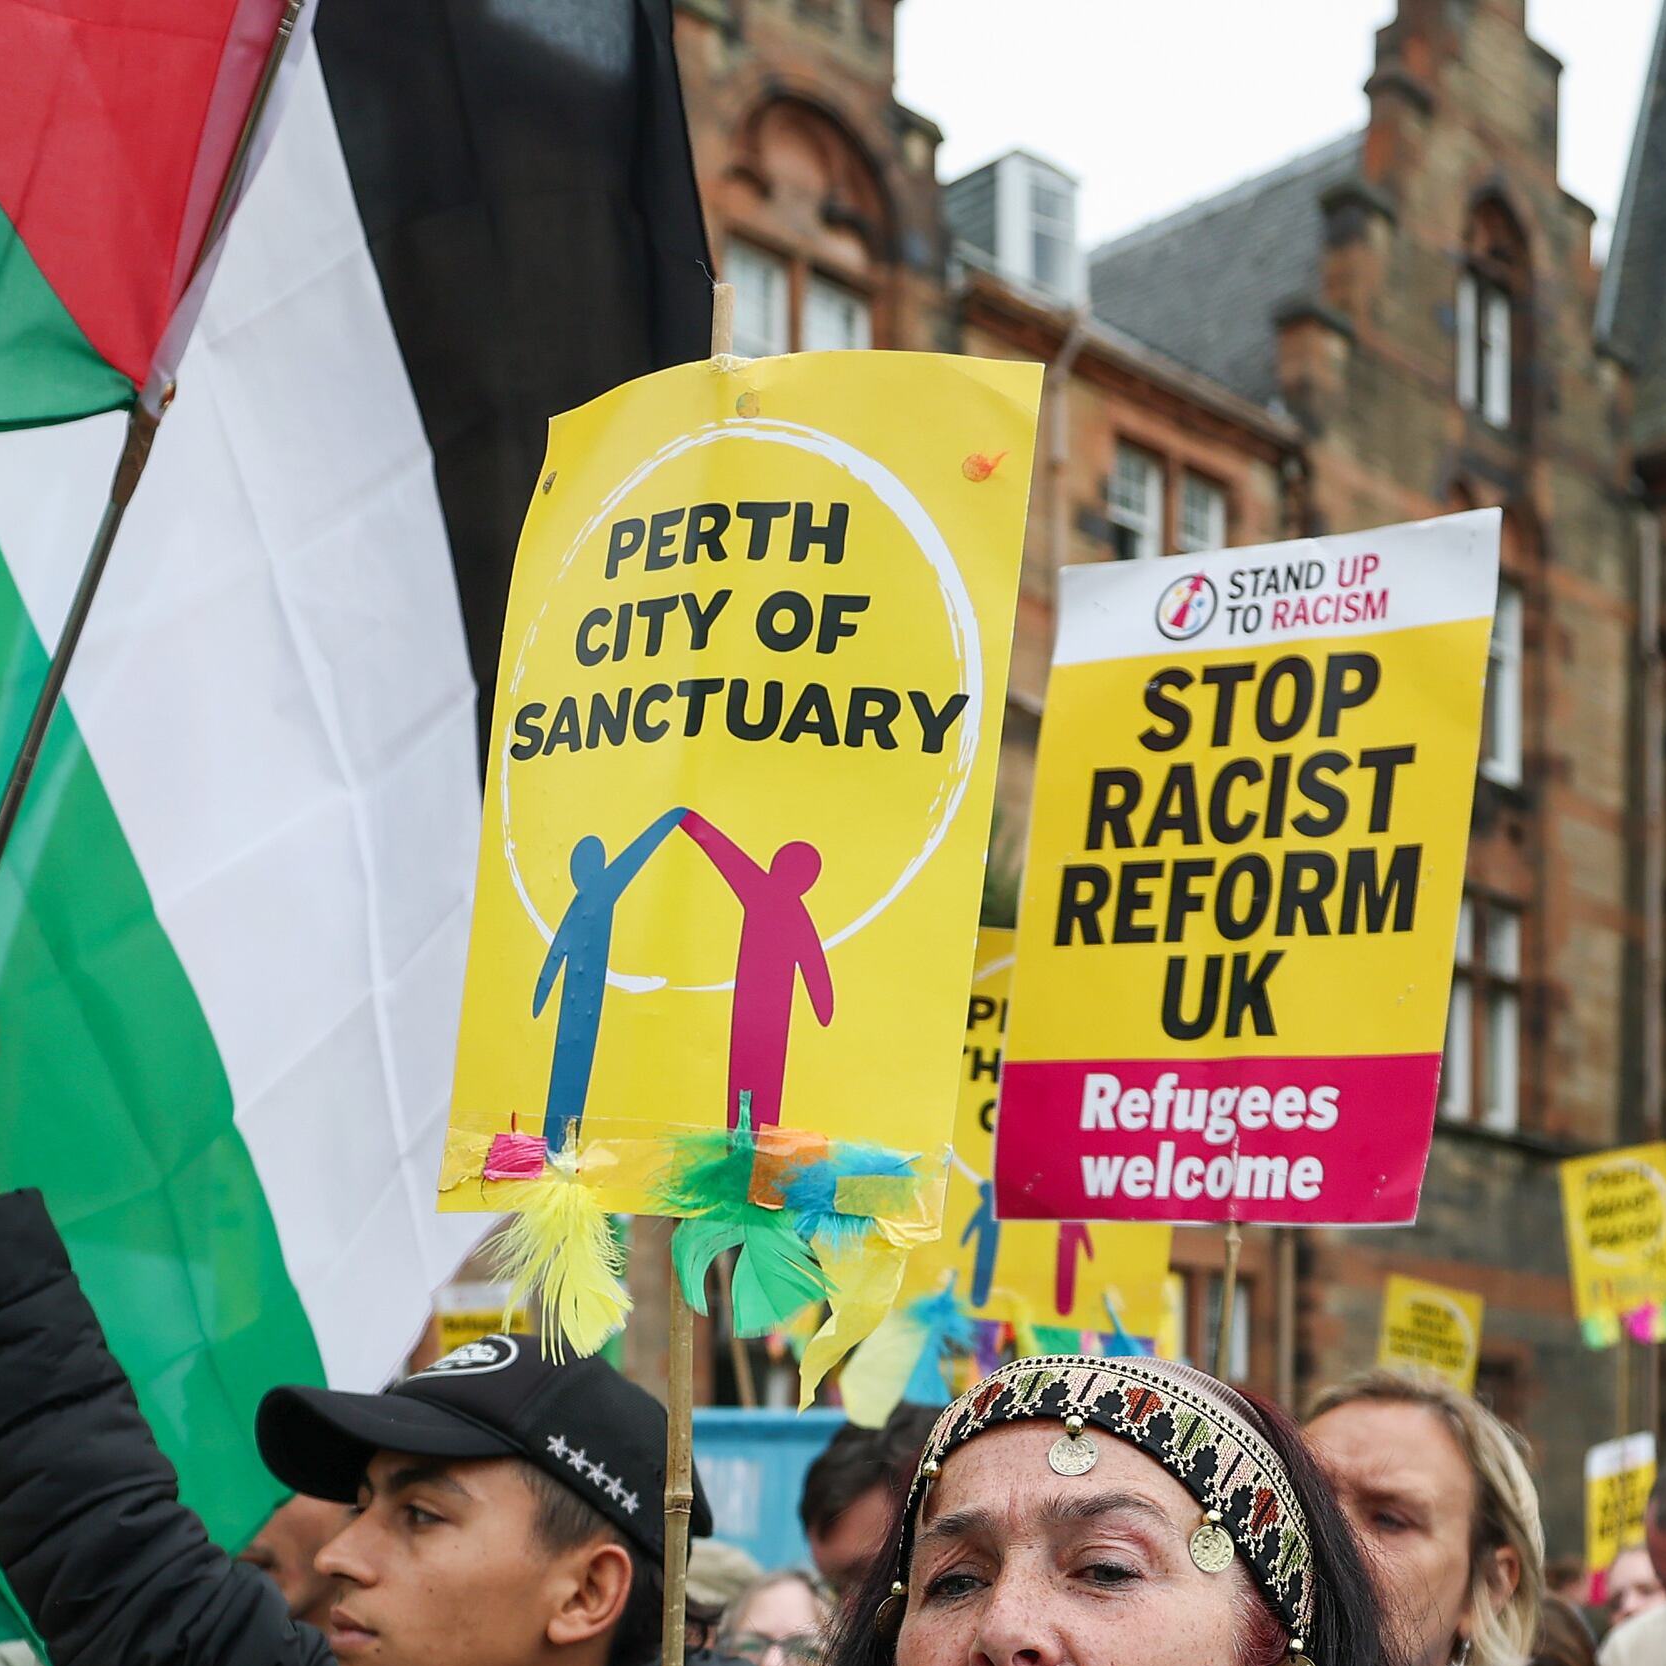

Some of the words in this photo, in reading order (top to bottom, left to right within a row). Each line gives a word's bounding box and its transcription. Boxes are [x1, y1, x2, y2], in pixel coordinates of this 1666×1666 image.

[604, 501, 850, 581] PERTH
[1228, 560, 1325, 599] STAND
[1337, 553, 1380, 588] UP
[575, 589, 732, 667] CITY
[755, 590, 871, 654] OF
[1226, 603, 1262, 635] TO
[1271, 588, 1389, 630] RACISM
[509, 677, 970, 762] SANCTUARY
[1138, 651, 1380, 752] STOP
[1086, 744, 1417, 851] RACIST
[1054, 844, 1423, 947] REFORM
[1161, 950, 1285, 1041] UK
[1079, 1072, 1340, 1145] Refugees
[1080, 1141, 1324, 1201] welcome
